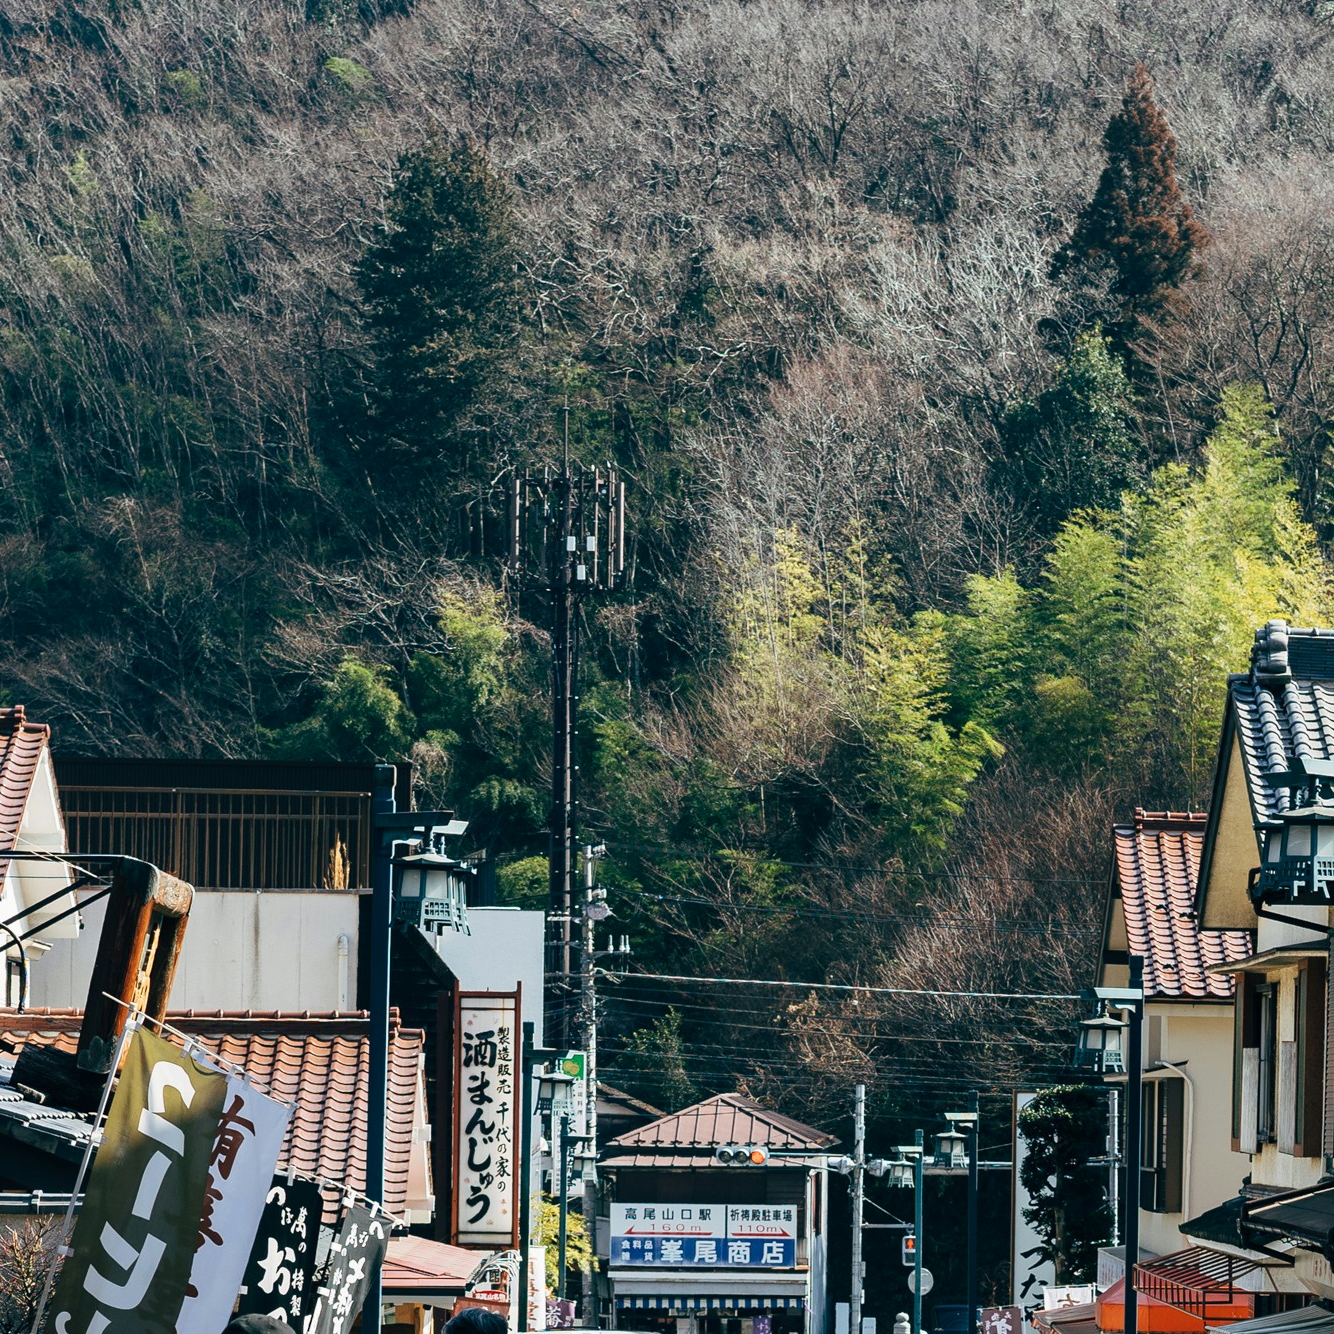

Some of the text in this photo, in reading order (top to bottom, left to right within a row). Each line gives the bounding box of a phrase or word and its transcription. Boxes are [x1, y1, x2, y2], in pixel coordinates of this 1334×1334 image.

[496, 1026, 512, 1095] 製造販売
[462, 1029, 498, 1225] 酒まんじゅう
[624, 1207, 712, 1221] 高尾山口駅
[729, 1208, 792, 1223] 祈祷殿駐車場
[738, 1224, 777, 1233] 110m
[621, 1239, 654, 1250] 食料品
[660, 1239, 785, 1264] 峯尾商店
